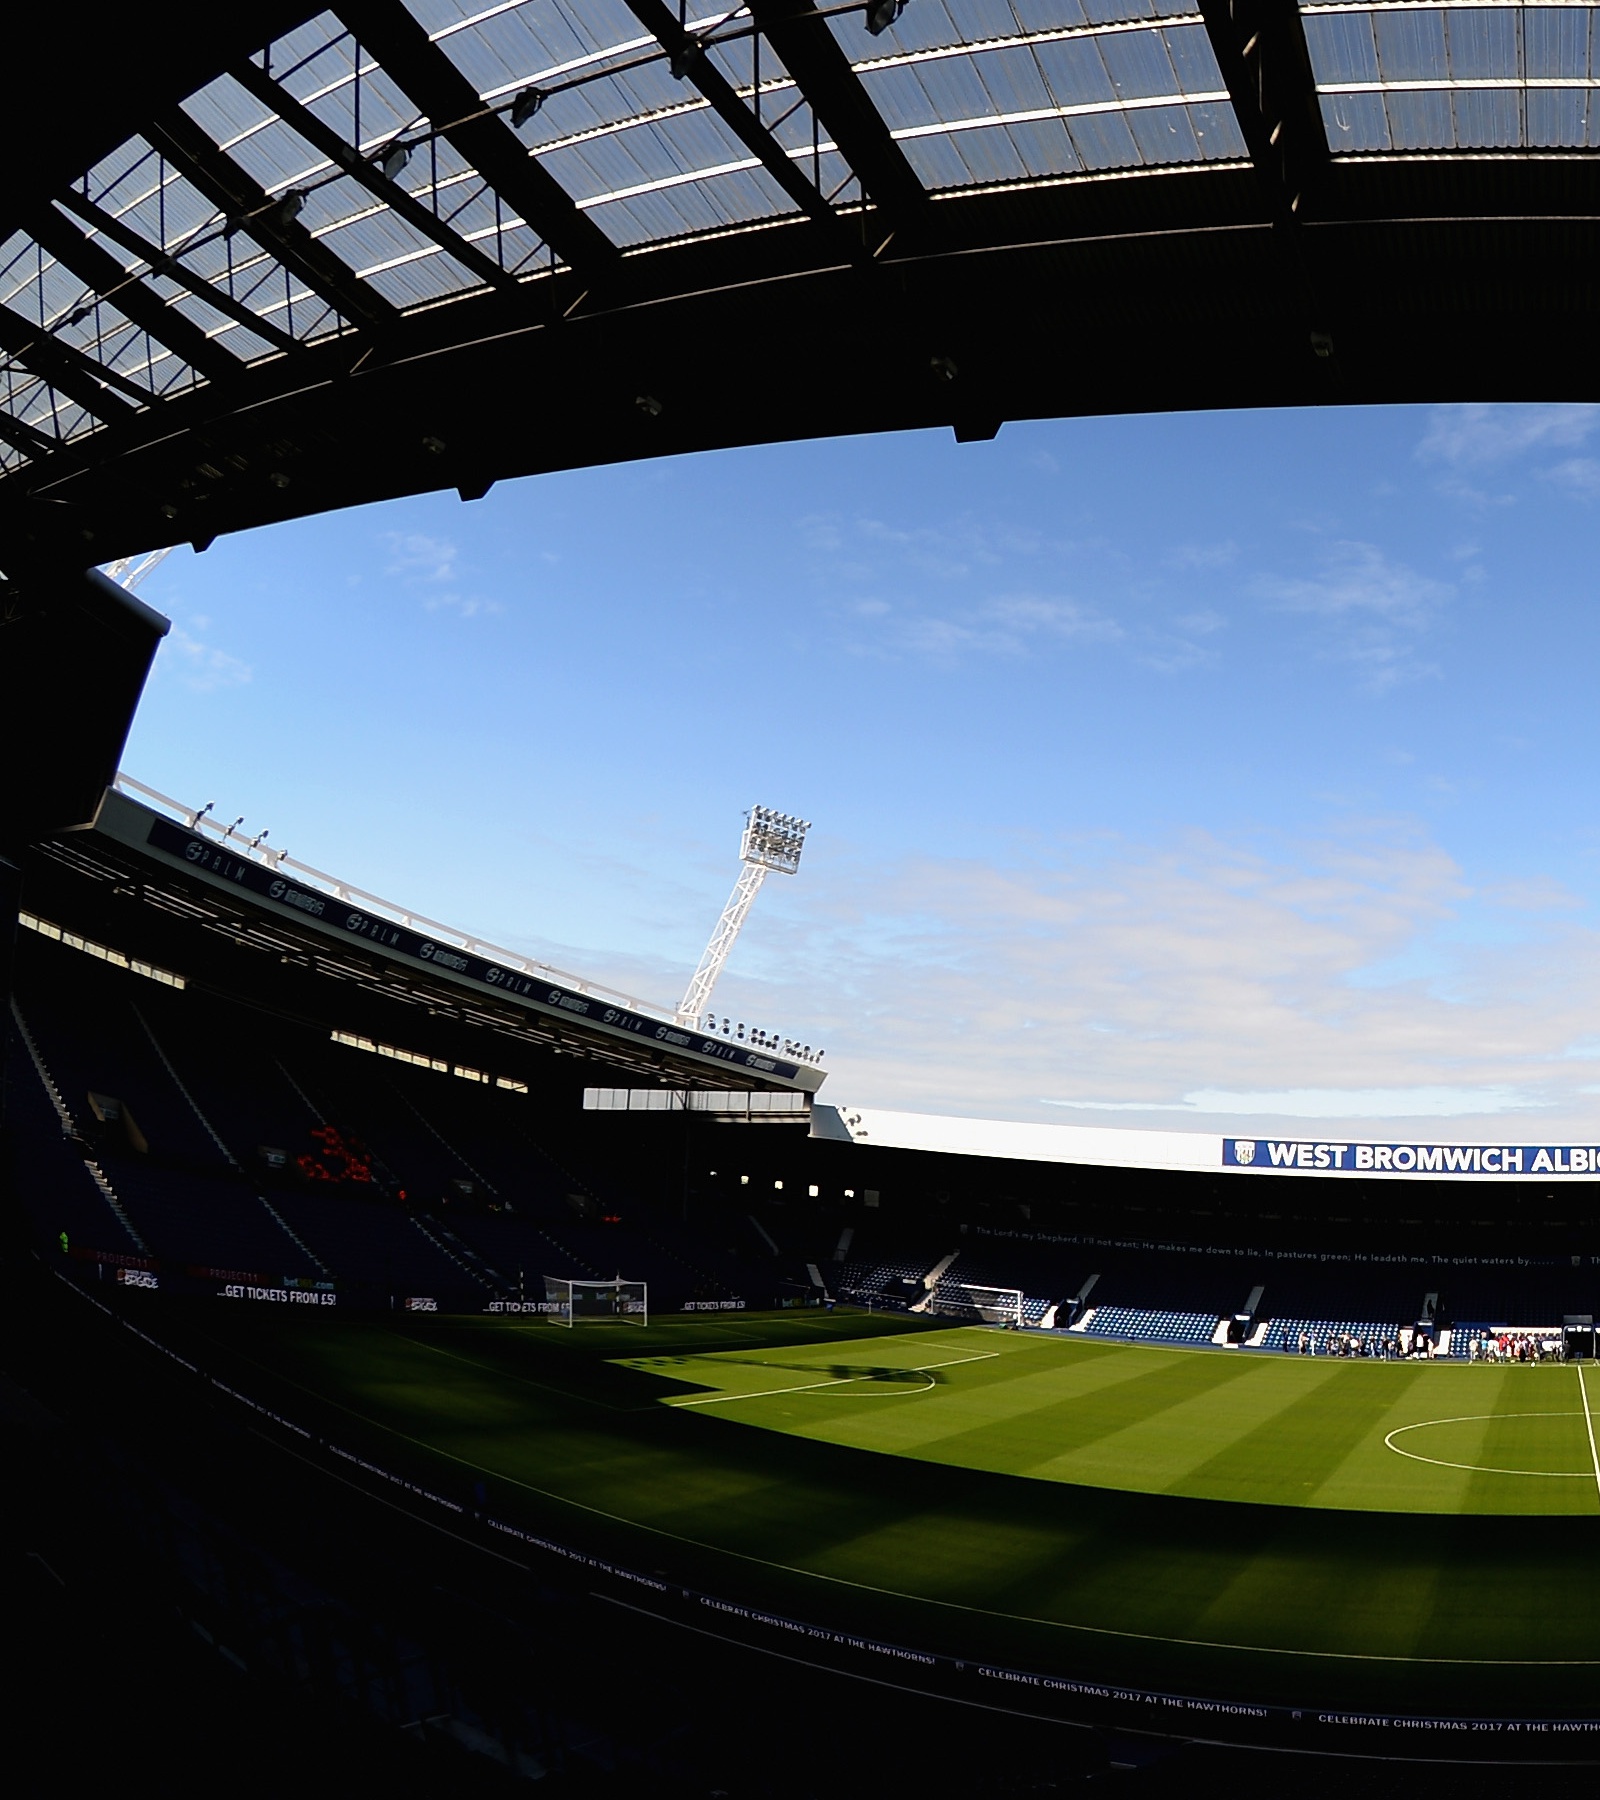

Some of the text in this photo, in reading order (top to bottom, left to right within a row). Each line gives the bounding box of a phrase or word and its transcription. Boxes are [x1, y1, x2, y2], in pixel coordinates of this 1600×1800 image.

[200, 850, 246, 881] PALM
[1267, 1142, 1348, 1169] WEST
[1355, 1145, 1523, 1172] BROMWICH
[1157, 1244, 1186, 1252] makes
[1206, 1246, 1231, 1255] down
[1276, 1251, 1317, 1259] pastures
[1371, 1254, 1407, 1262] leadeth
[1431, 1255, 1449, 1264] The
[1452, 1256, 1477, 1265] quiet
[1481, 1256, 1514, 1264] waters
[247, 1286, 287, 1302] TICKETS
[289, 1290, 318, 1305] FROM
[320, 1293, 336, 1306] £5!
[505, 1302, 536, 1312] TICETS
[700, 1597, 936, 1665] CELEBRATE CHRISTMAS 2017 AT THE HAWTHORNS!
[978, 1667, 1268, 1717] CELEBRATE CHRISTMAS 2017 AT THE HAWTHORNS!
[1318, 1714, 1389, 1727] CELEBRATE
[1393, 1719, 1467, 1730] CHRISTMAS
[1472, 1722, 1502, 1731] 2017
[1507, 1723, 1520, 1732] AT
[1526, 1723, 1548, 1732] THE
